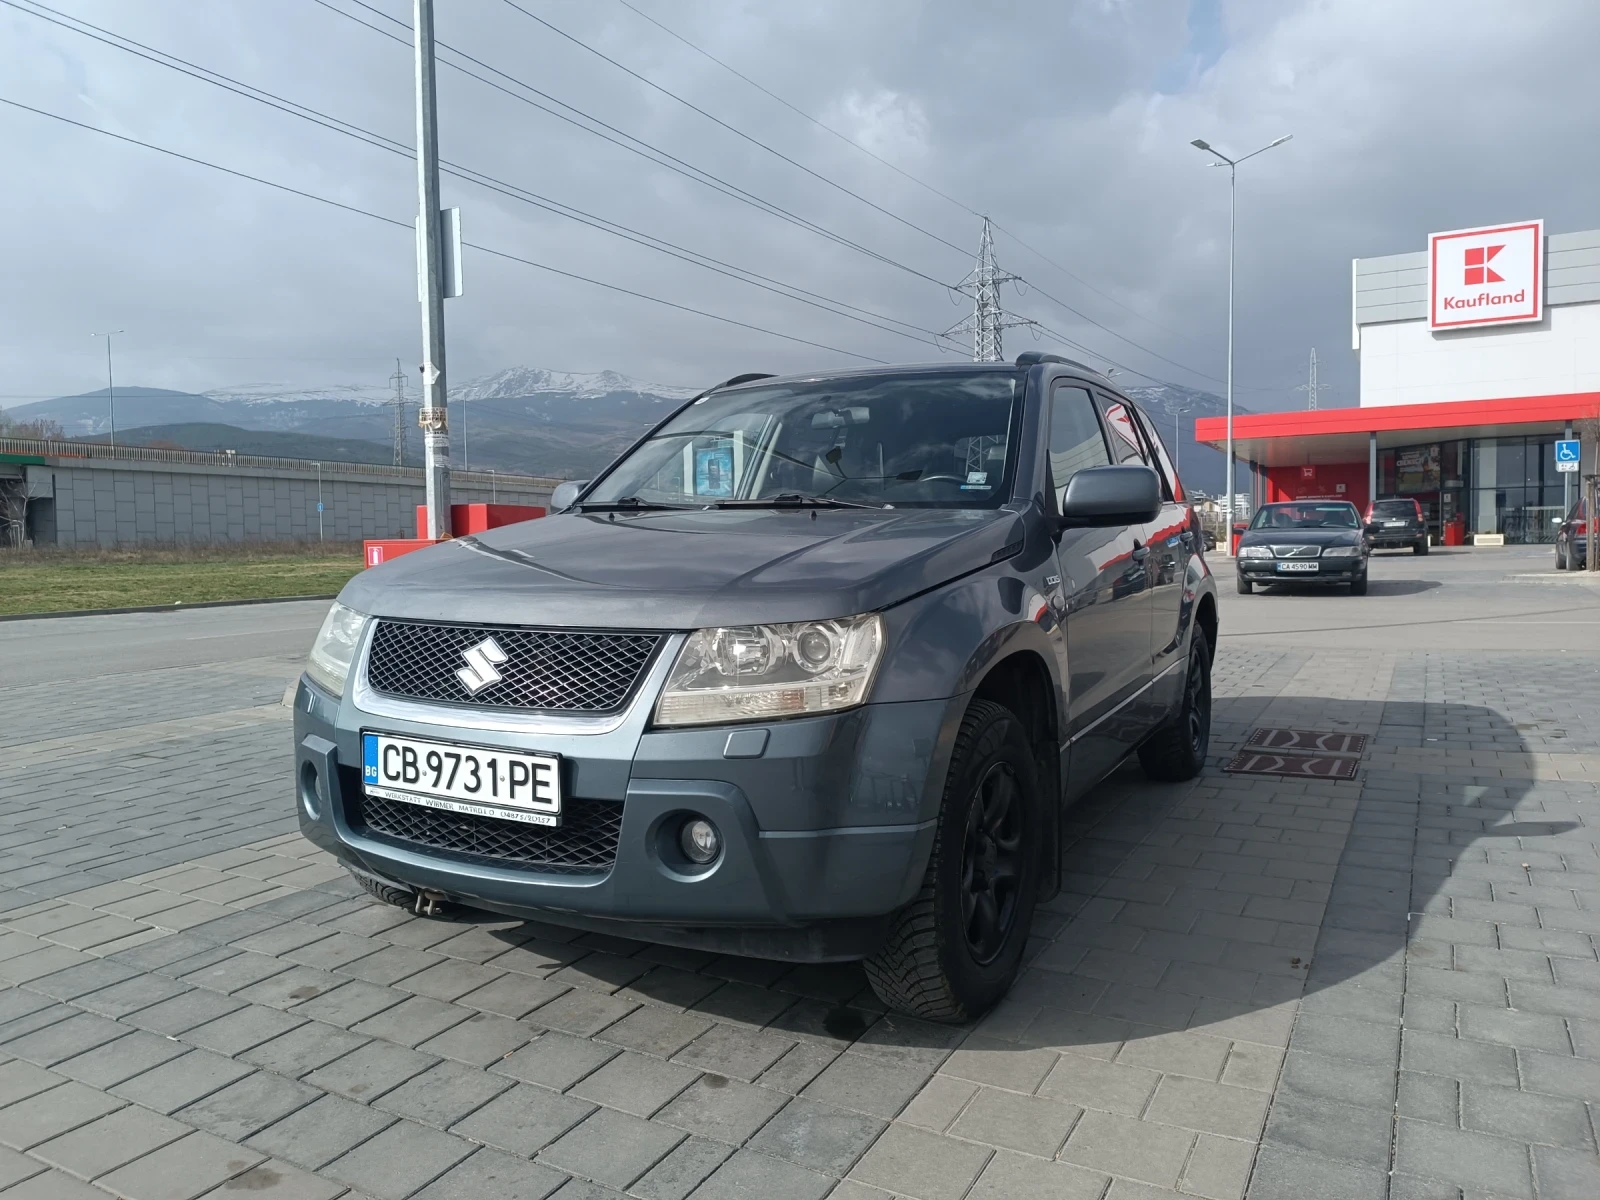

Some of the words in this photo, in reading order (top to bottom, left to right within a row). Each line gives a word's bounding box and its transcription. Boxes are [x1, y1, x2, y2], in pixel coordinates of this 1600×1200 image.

[1444, 289, 1525, 310] Kaufland
[365, 765, 378, 777] BG
[383, 744, 420, 784] CB
[426, 750, 498, 797] 9731
[509, 760, 553, 805] PE
